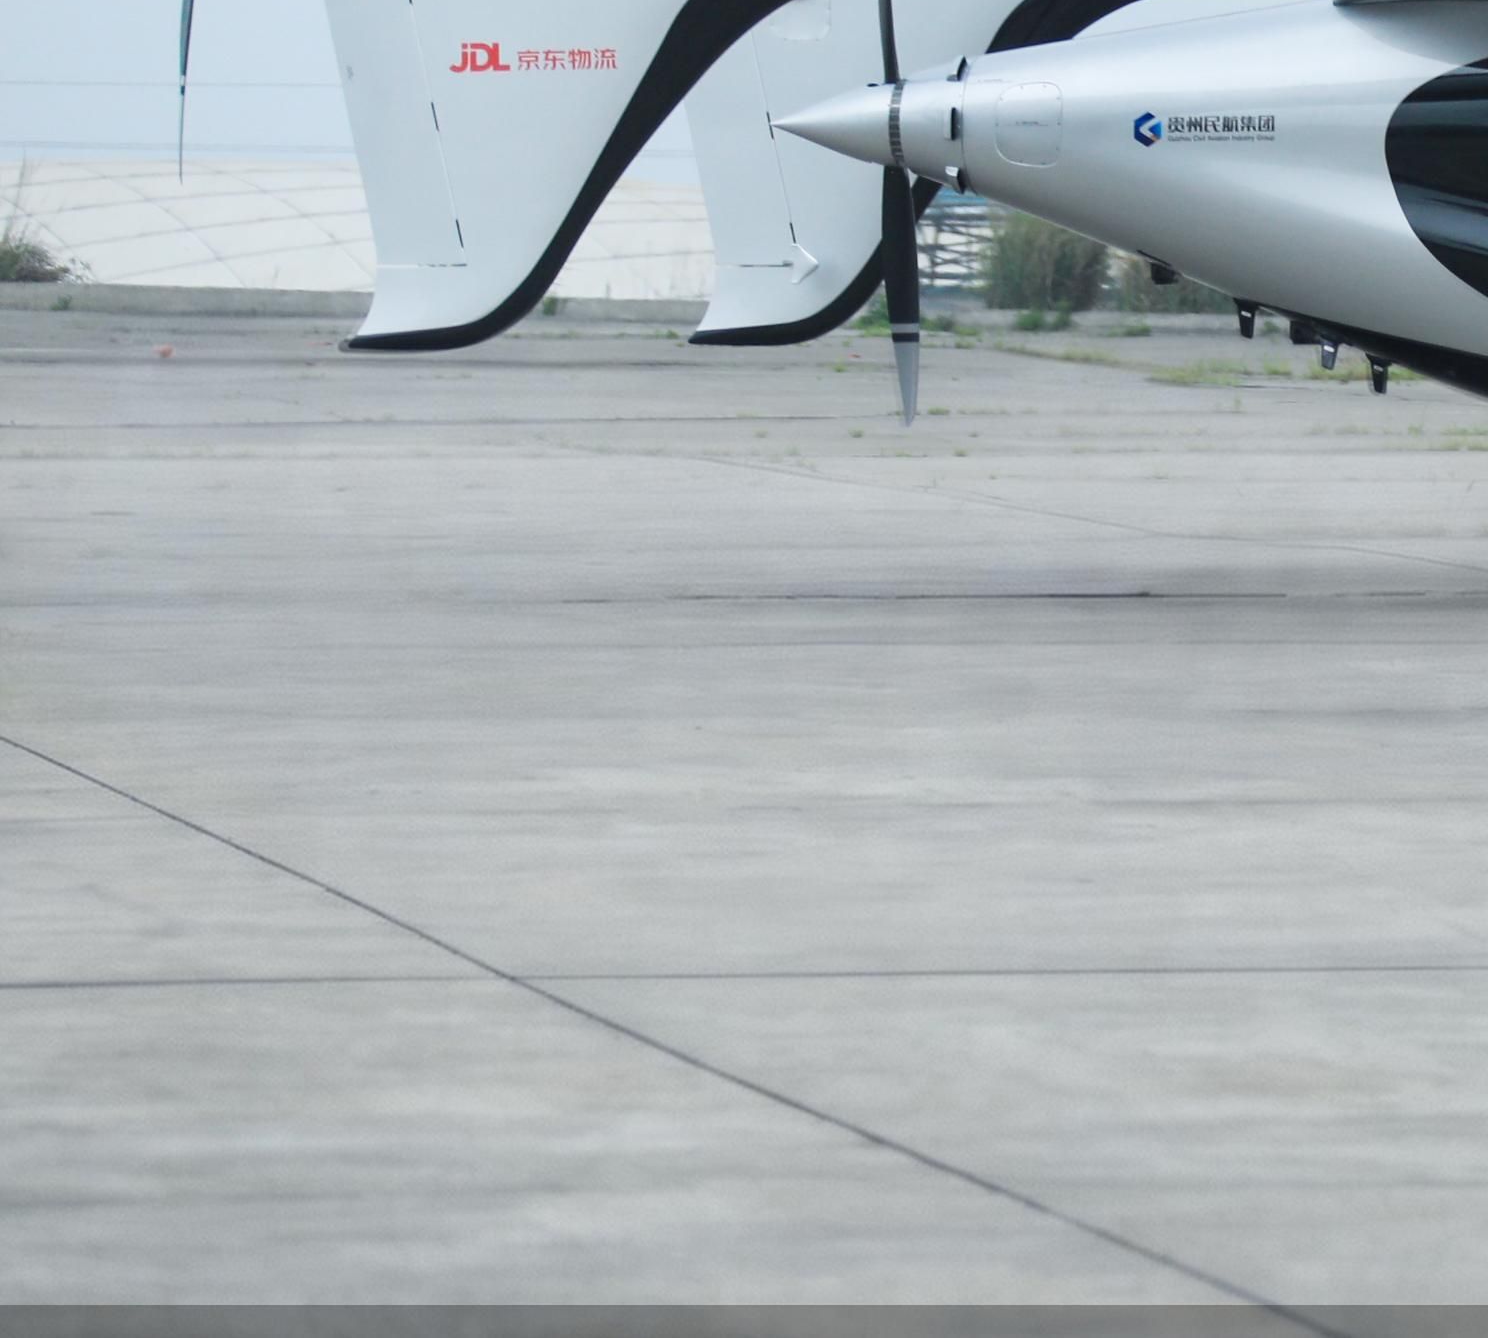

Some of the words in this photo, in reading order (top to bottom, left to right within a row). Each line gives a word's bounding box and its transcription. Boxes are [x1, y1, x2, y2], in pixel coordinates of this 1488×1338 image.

[450, 42, 511, 73] JDL
[517, 48, 618, 70] 京东物流
[1168, 116, 1275, 132] 贵州民航集团
